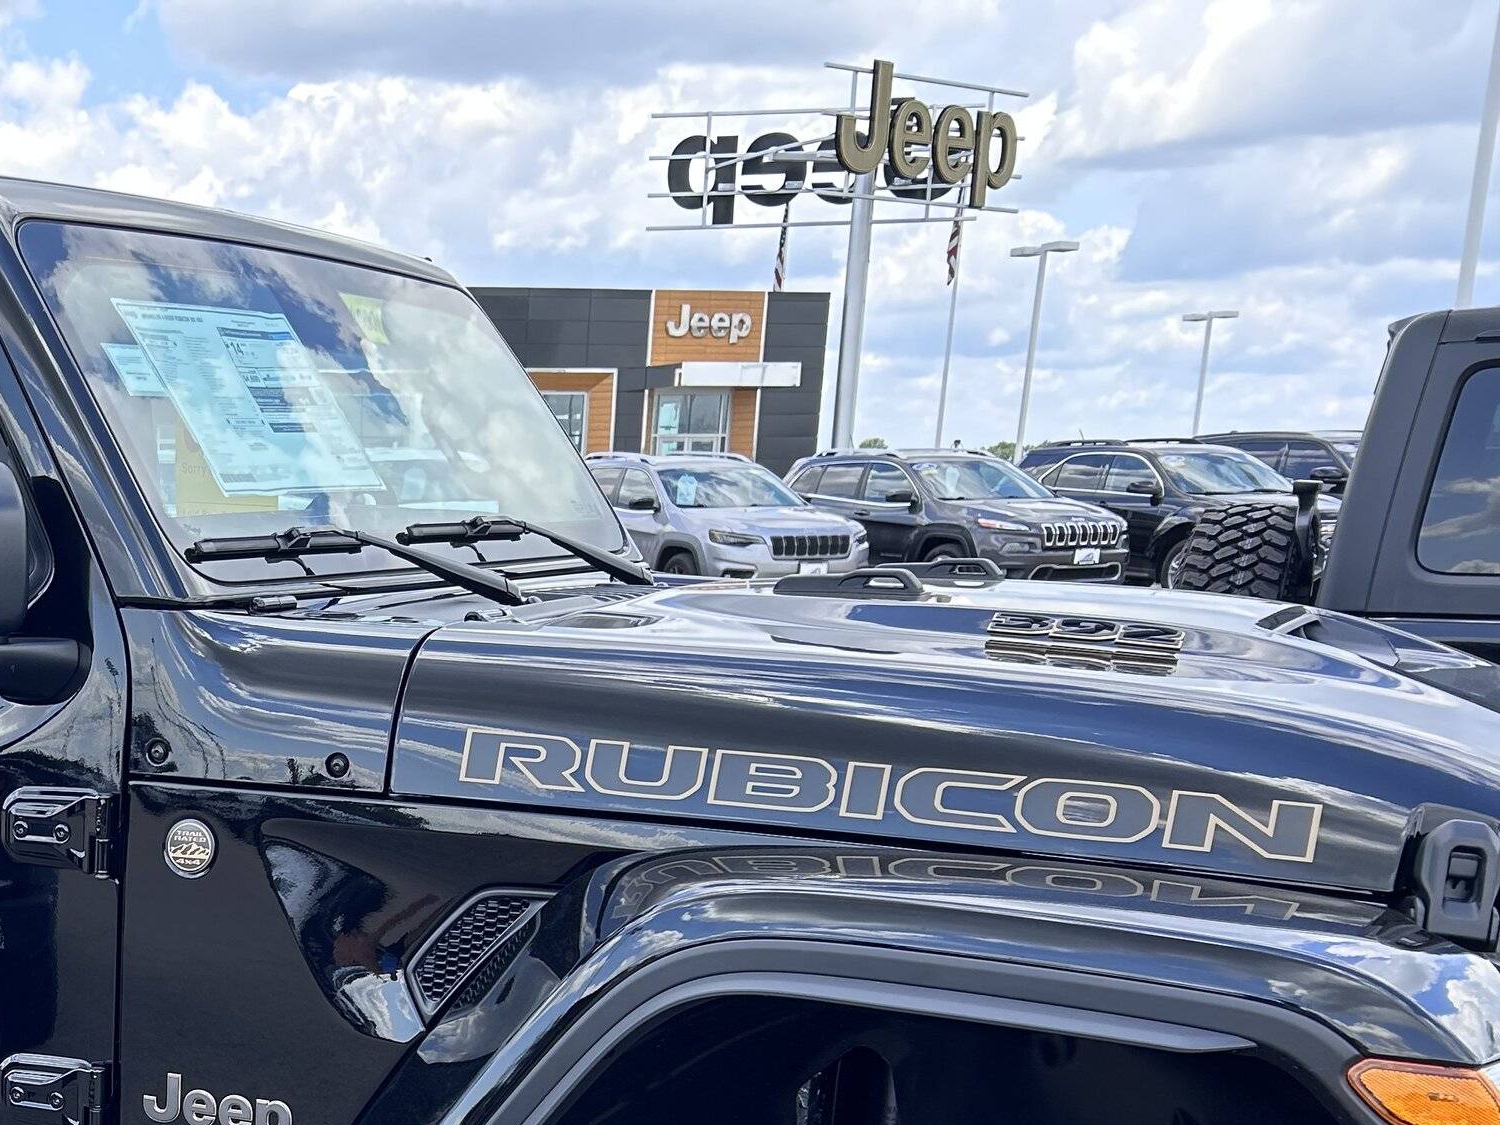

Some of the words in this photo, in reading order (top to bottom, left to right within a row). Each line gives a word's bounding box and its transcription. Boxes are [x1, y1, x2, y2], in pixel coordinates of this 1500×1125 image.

[835, 59, 1018, 209] Jeep
[665, 303, 752, 344] Jeep
[986, 611, 1187, 650] 392
[460, 727, 1321, 863] RUBICON
